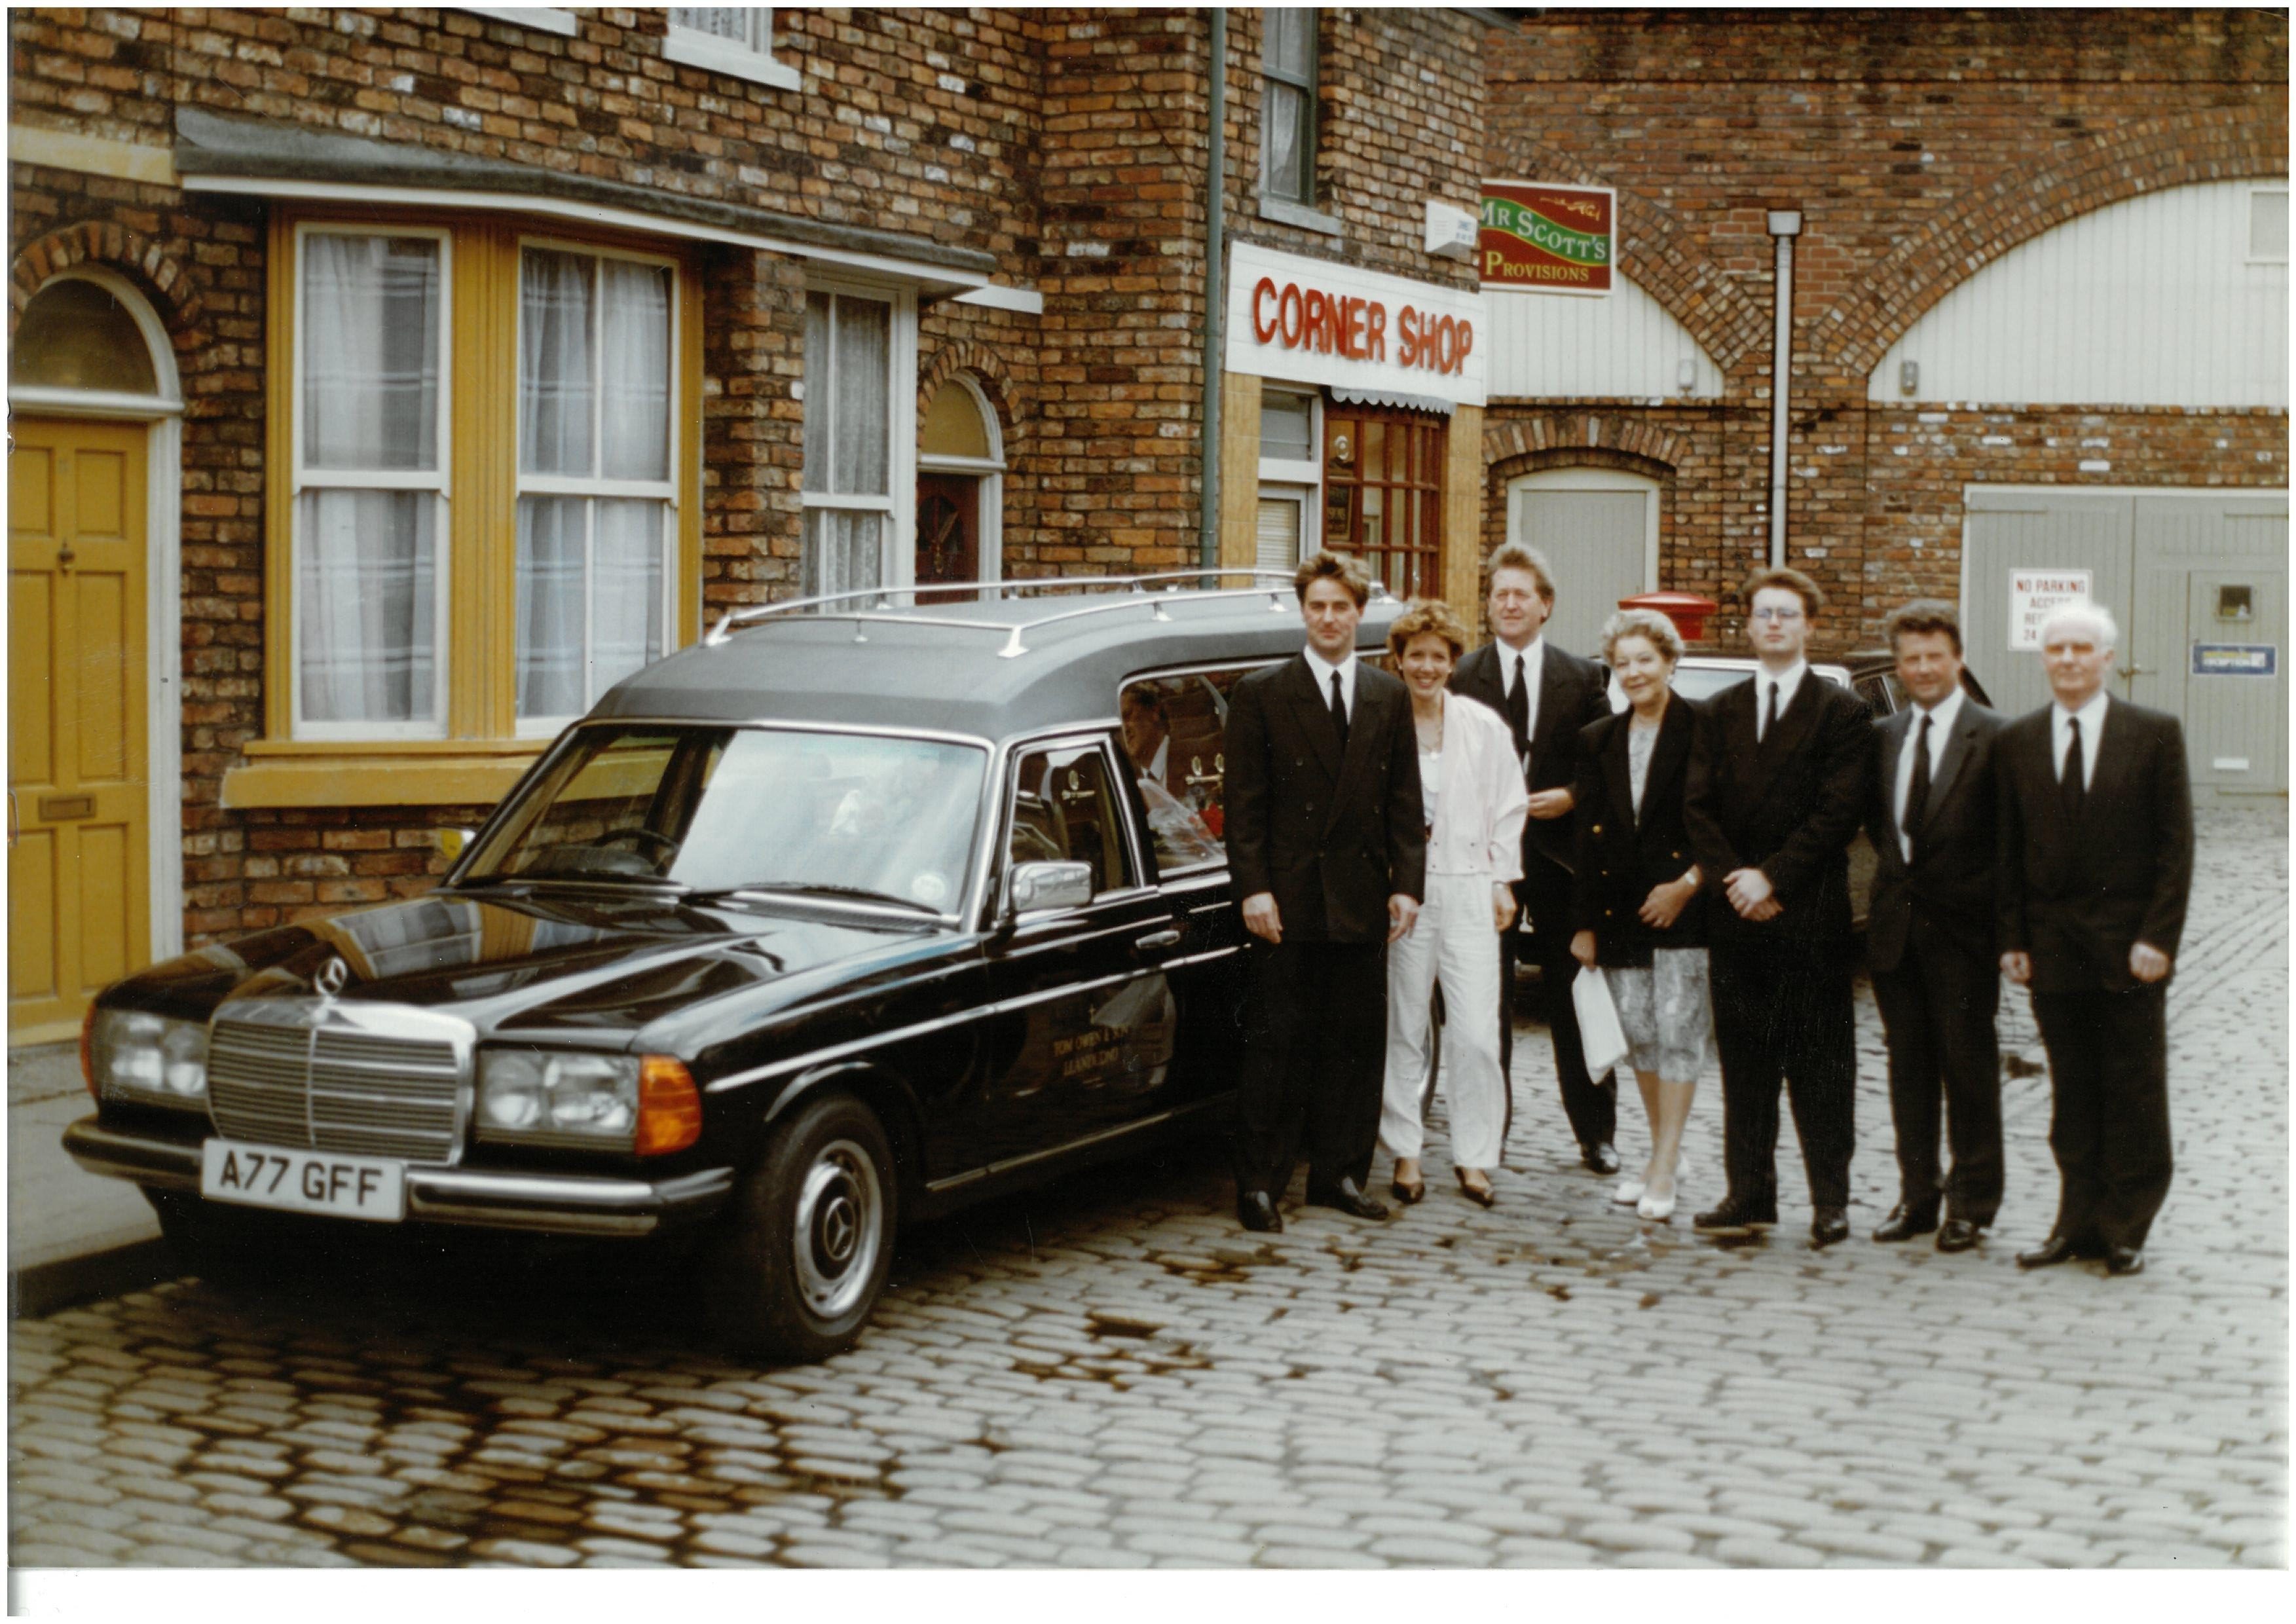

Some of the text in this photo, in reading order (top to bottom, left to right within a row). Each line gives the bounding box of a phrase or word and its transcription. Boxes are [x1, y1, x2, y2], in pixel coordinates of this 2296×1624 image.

[1517, 210, 1606, 260] SCOTT'S
[1485, 251, 1589, 282] PROVISIONS
[1253, 276, 1472, 375] CORNER SHOP
[2016, 579, 2084, 593] NO PARKING
[2024, 629, 2037, 642] 24
[221, 1150, 382, 1206] A77 GFF
